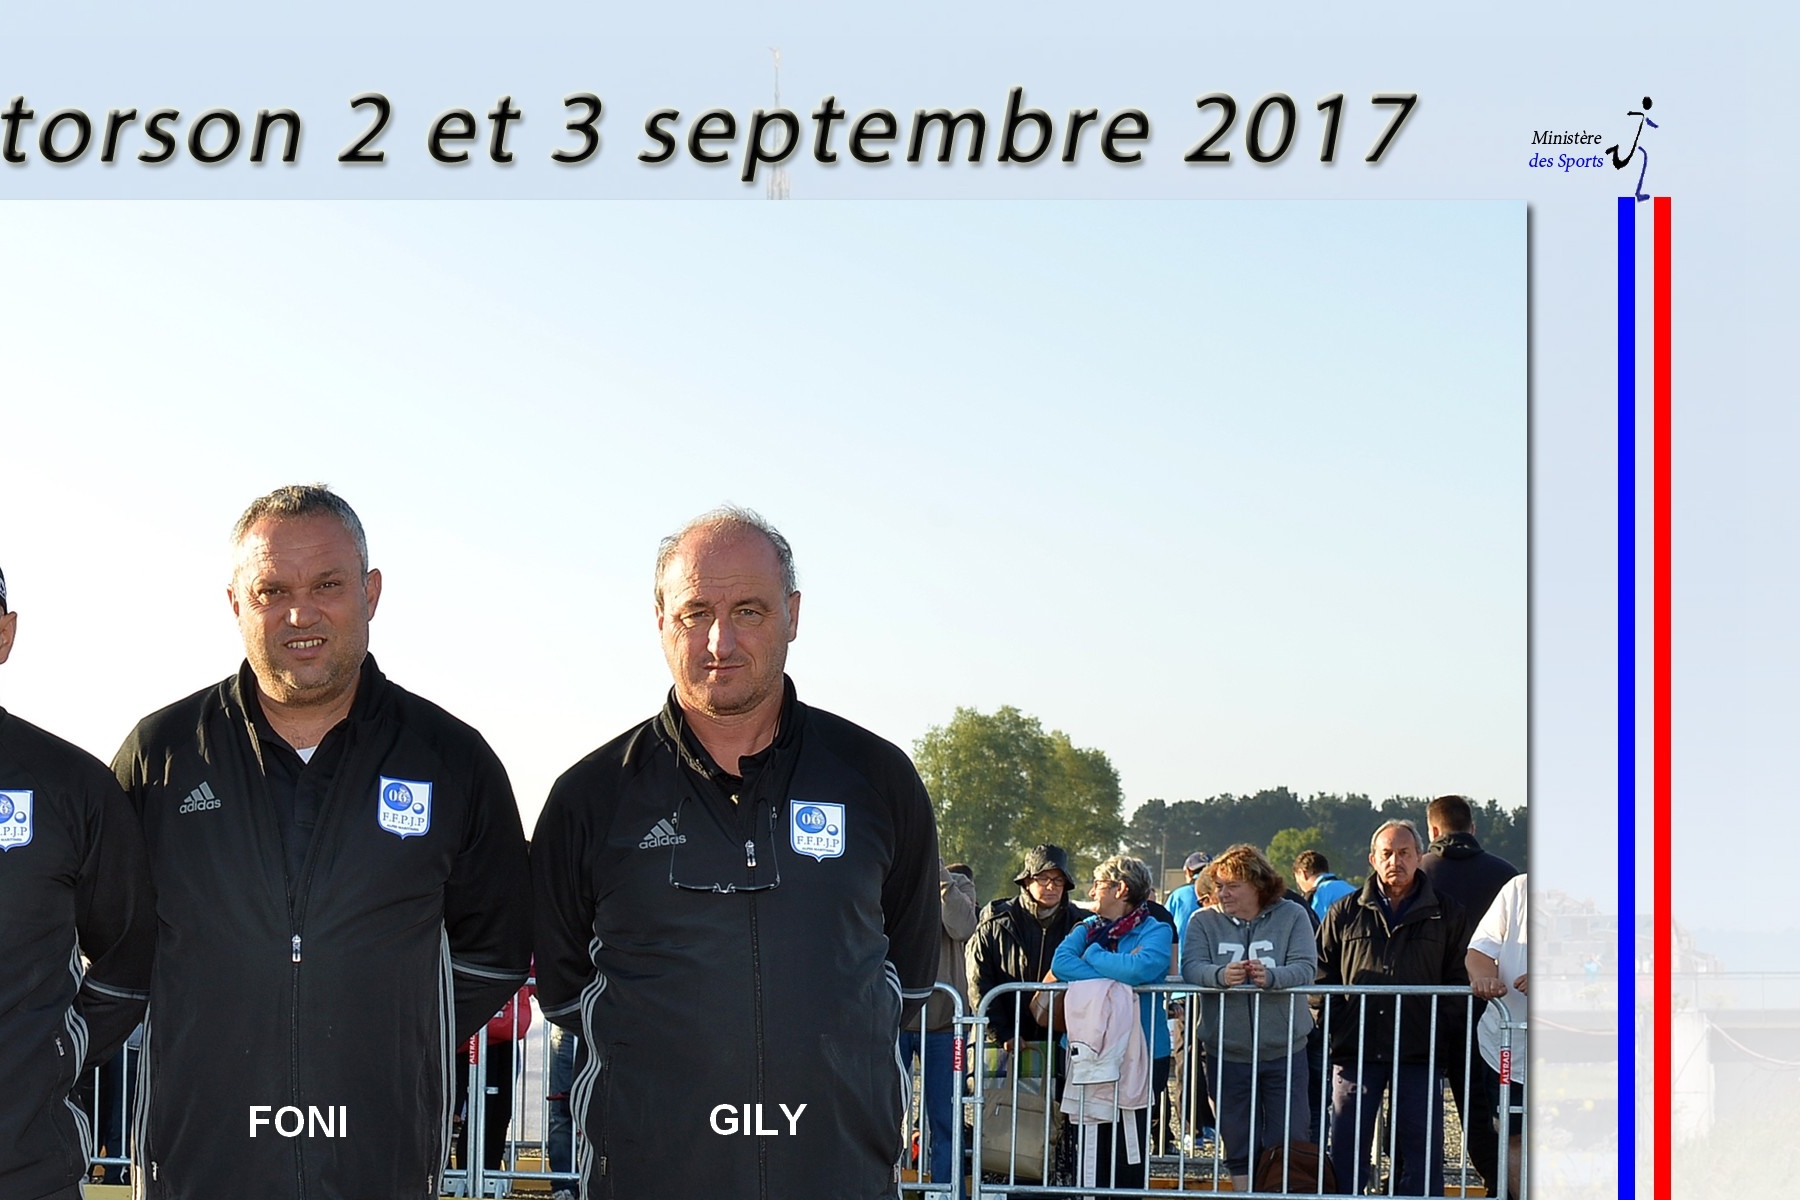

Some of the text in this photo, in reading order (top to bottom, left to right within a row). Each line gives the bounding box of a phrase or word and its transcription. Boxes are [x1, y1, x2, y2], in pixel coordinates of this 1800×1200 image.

[179, 797, 222, 814] adidas
[639, 833, 687, 850] adidas
[1218, 940, 1276, 968] 76
[954, 1039, 963, 1071] ALTRAD
[1502, 1051, 1511, 1083] ALTRAD
